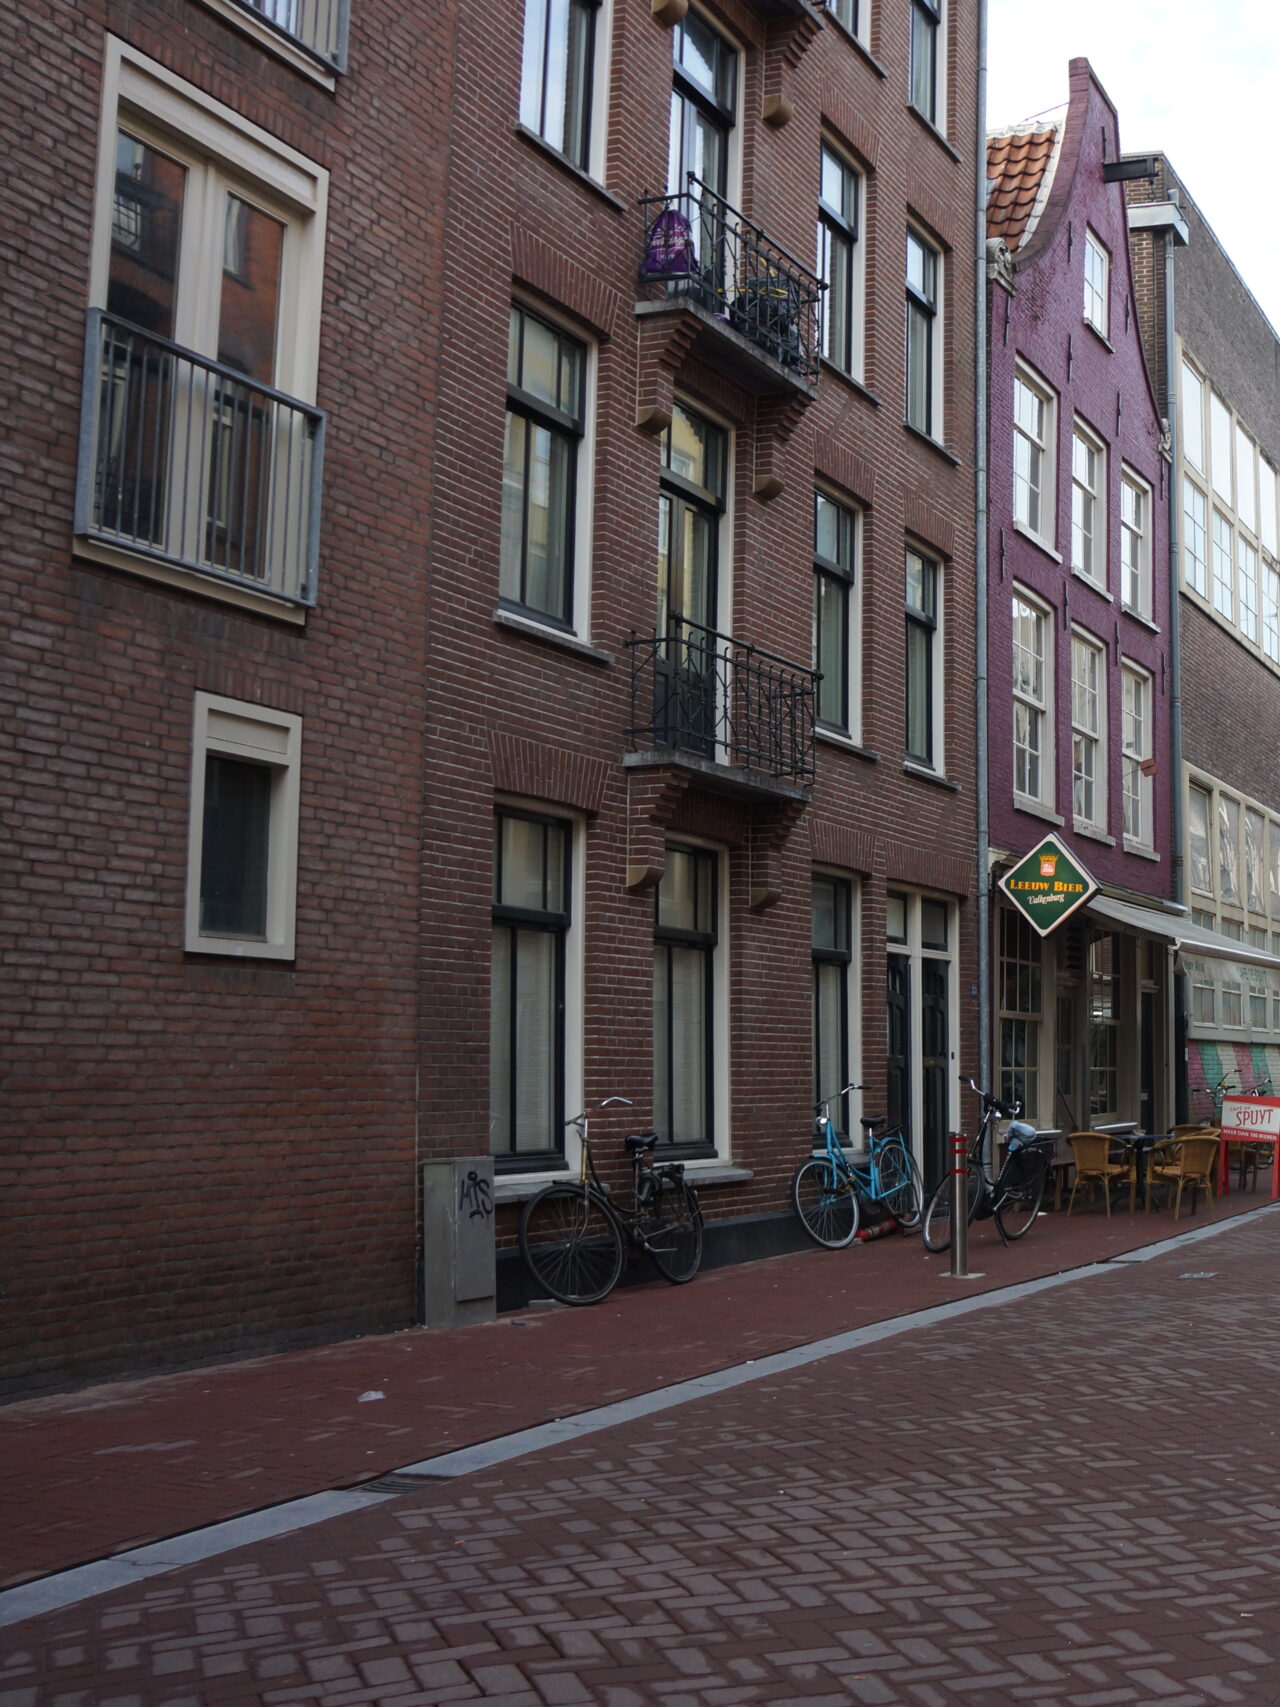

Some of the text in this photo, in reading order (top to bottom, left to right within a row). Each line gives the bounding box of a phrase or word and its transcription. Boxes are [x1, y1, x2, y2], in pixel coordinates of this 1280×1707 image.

[1010, 879, 1084, 893] LEEUW BIER
[1235, 1109, 1274, 1127] SPUYT
